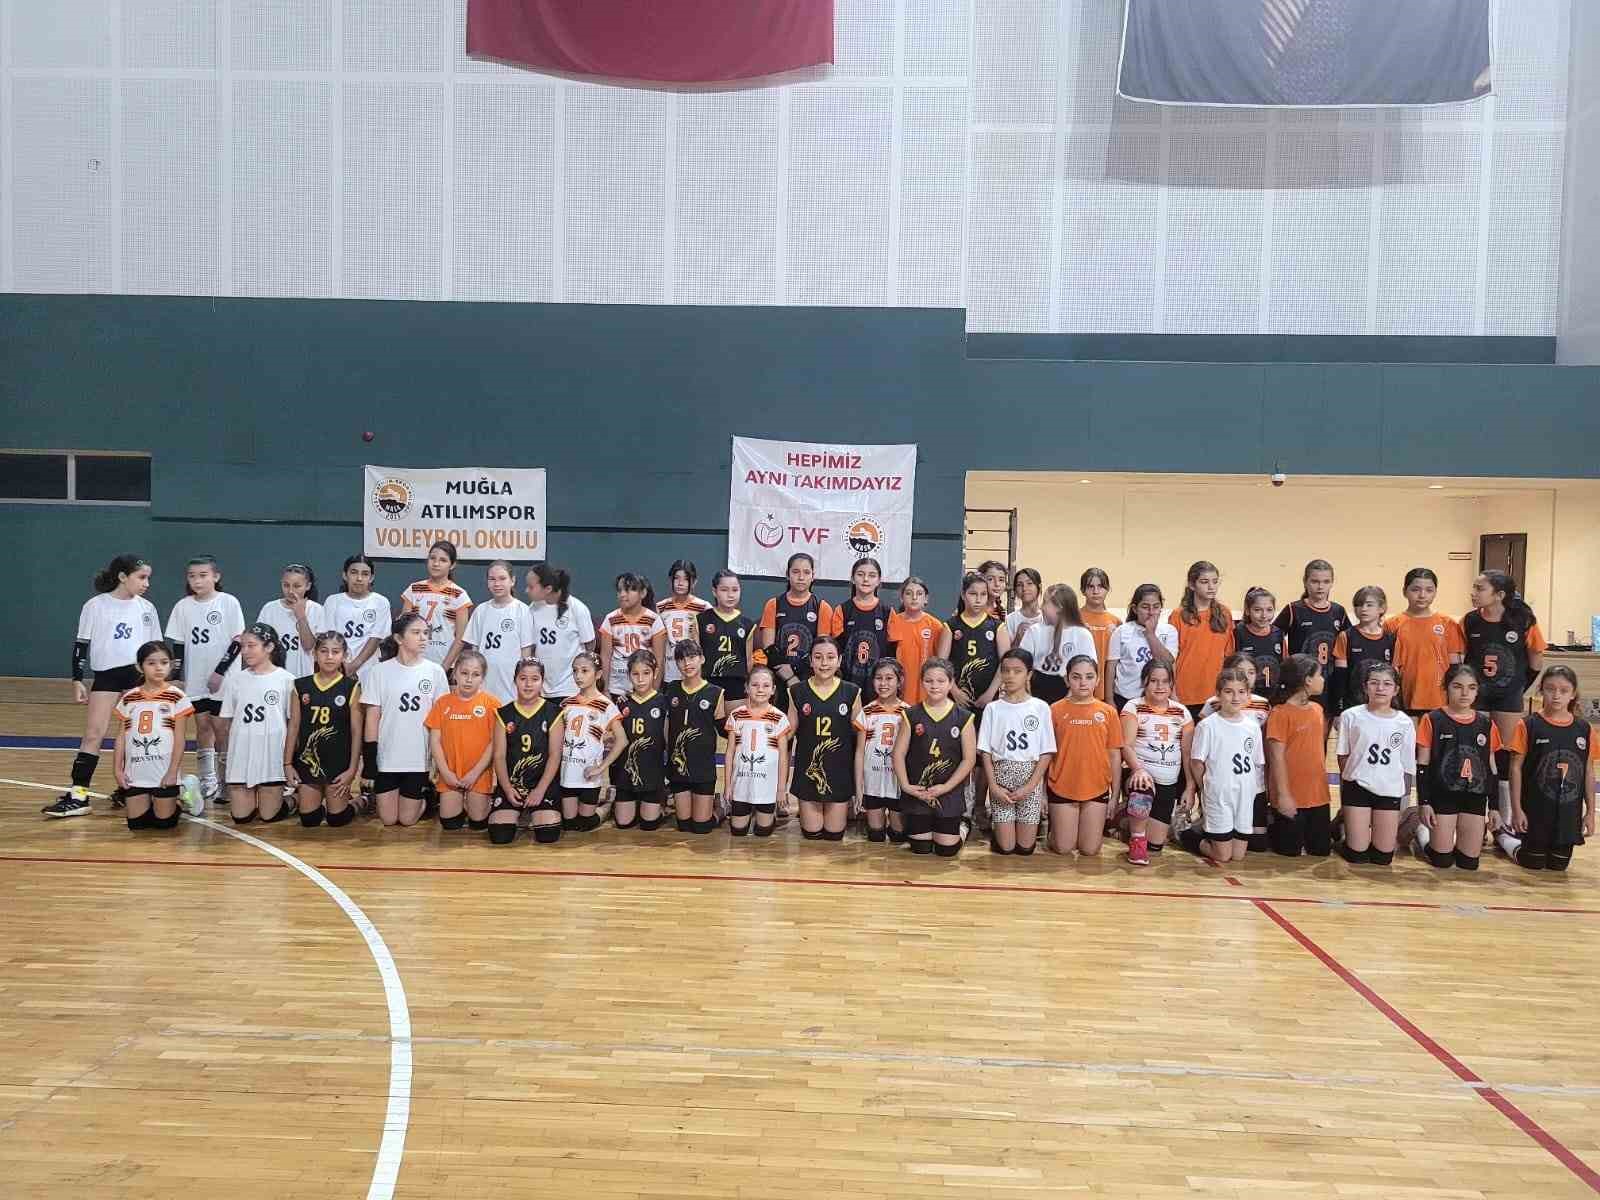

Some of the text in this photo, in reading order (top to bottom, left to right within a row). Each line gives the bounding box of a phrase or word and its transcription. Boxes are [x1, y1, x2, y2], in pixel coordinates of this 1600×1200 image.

[787, 451, 862, 469] HEPİMİZ
[446, 477, 513, 496] MUĞLA
[745, 470, 902, 490] AYNI TAKIMDAYIZ
[421, 504, 536, 521] ATILIMSPOR
[376, 527, 538, 550] VOLEYBOL OKULU
[788, 526, 830, 544] TVF
[426, 600, 438, 622] 7
[671, 617, 684, 639] 5
[624, 632, 641, 654] 10
[718, 635, 731, 652] 21
[787, 635, 801, 656] 2
[858, 642, 870, 663] 6
[967, 639, 977, 656] 5
[1317, 643, 1328, 665] 8
[1262, 665, 1271, 688] 1
[1483, 655, 1498, 677] 5
[138, 711, 153, 734] 8
[310, 706, 330, 725] 78
[631, 717, 644, 735] 16
[683, 709, 688, 726] 1
[815, 716, 832, 737] 12
[881, 723, 895, 745] 2
[1154, 724, 1168, 741] 3
[520, 733, 531, 753] 9
[751, 728, 757, 751] 1
[929, 739, 941, 757] 4
[1460, 758, 1472, 779] 4
